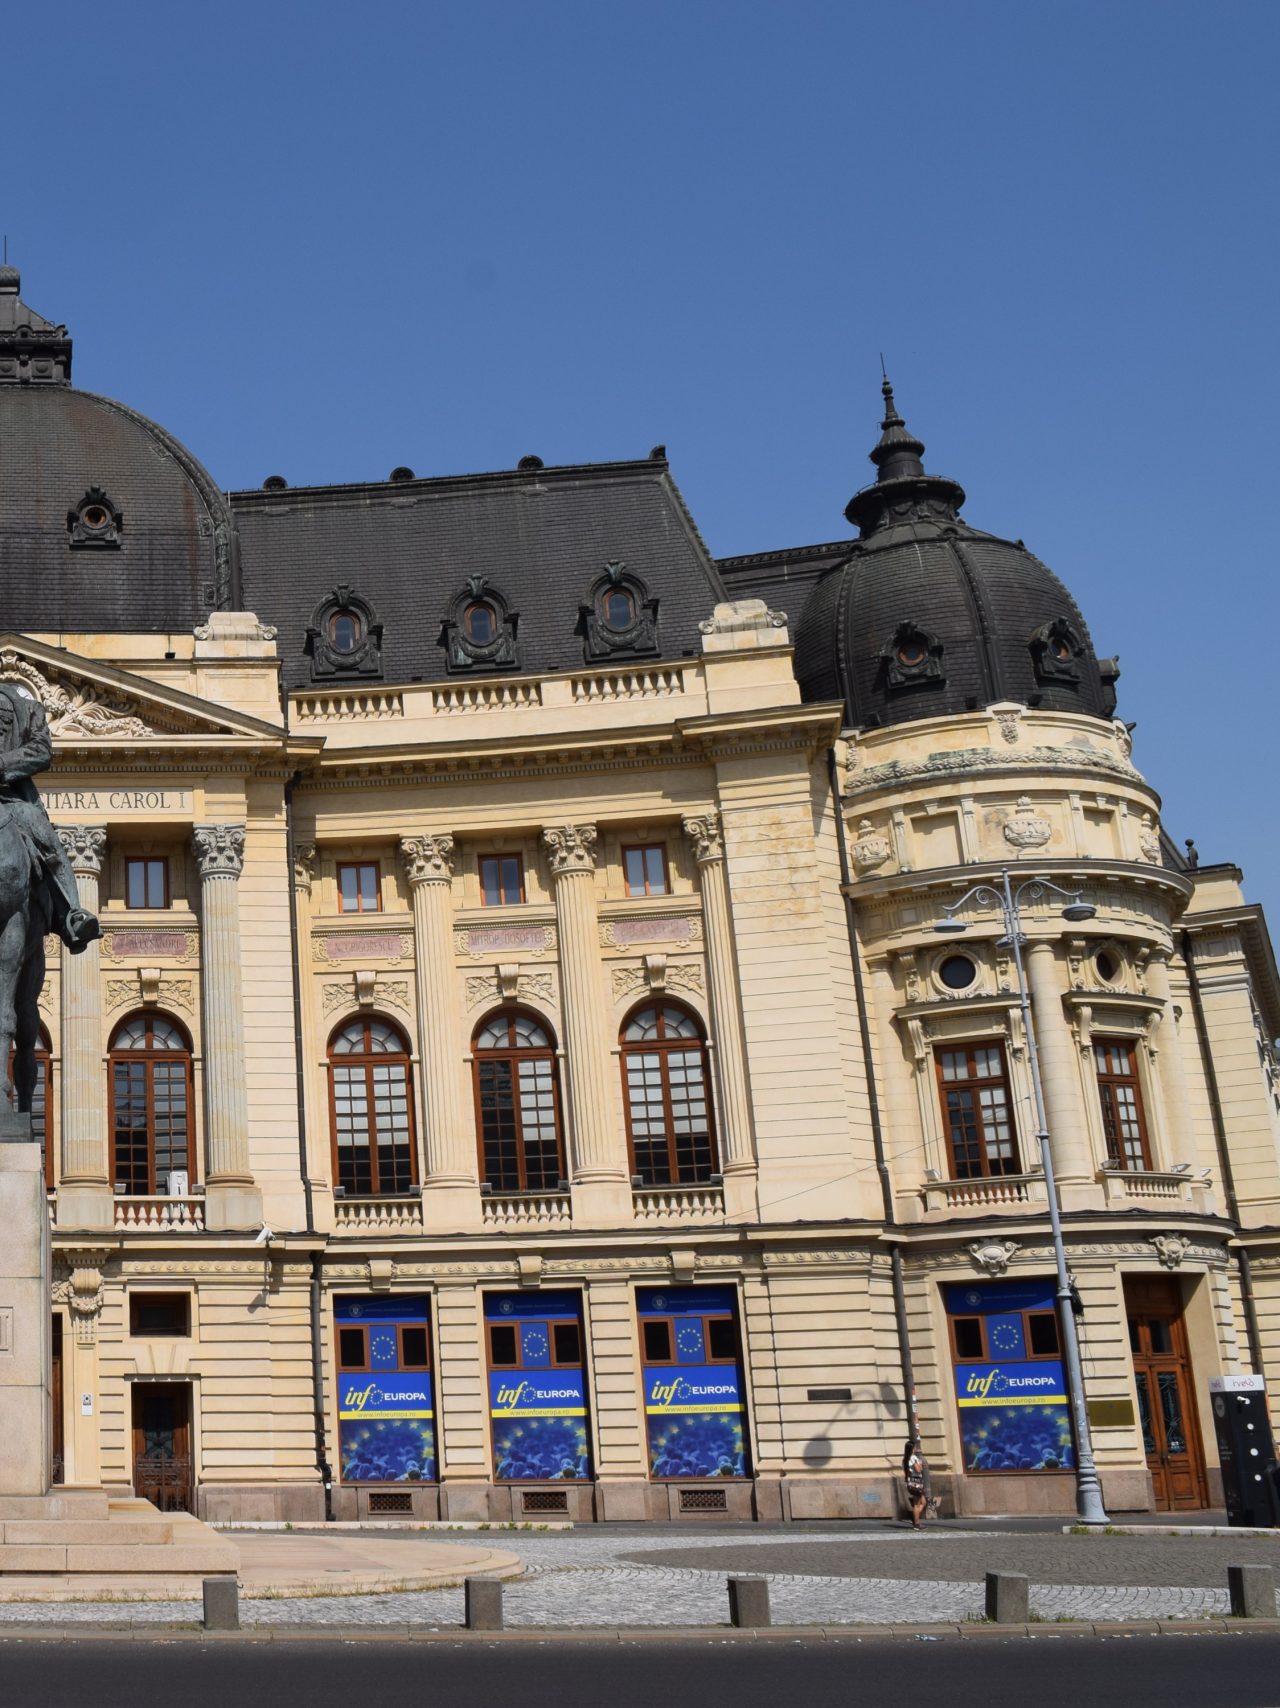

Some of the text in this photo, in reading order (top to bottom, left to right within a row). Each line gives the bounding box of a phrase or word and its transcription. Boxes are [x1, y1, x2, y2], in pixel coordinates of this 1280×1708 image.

[39, 792, 100, 809] ITARA
[109, 792, 171, 809] CAROL
[179, 792, 186, 809] I
